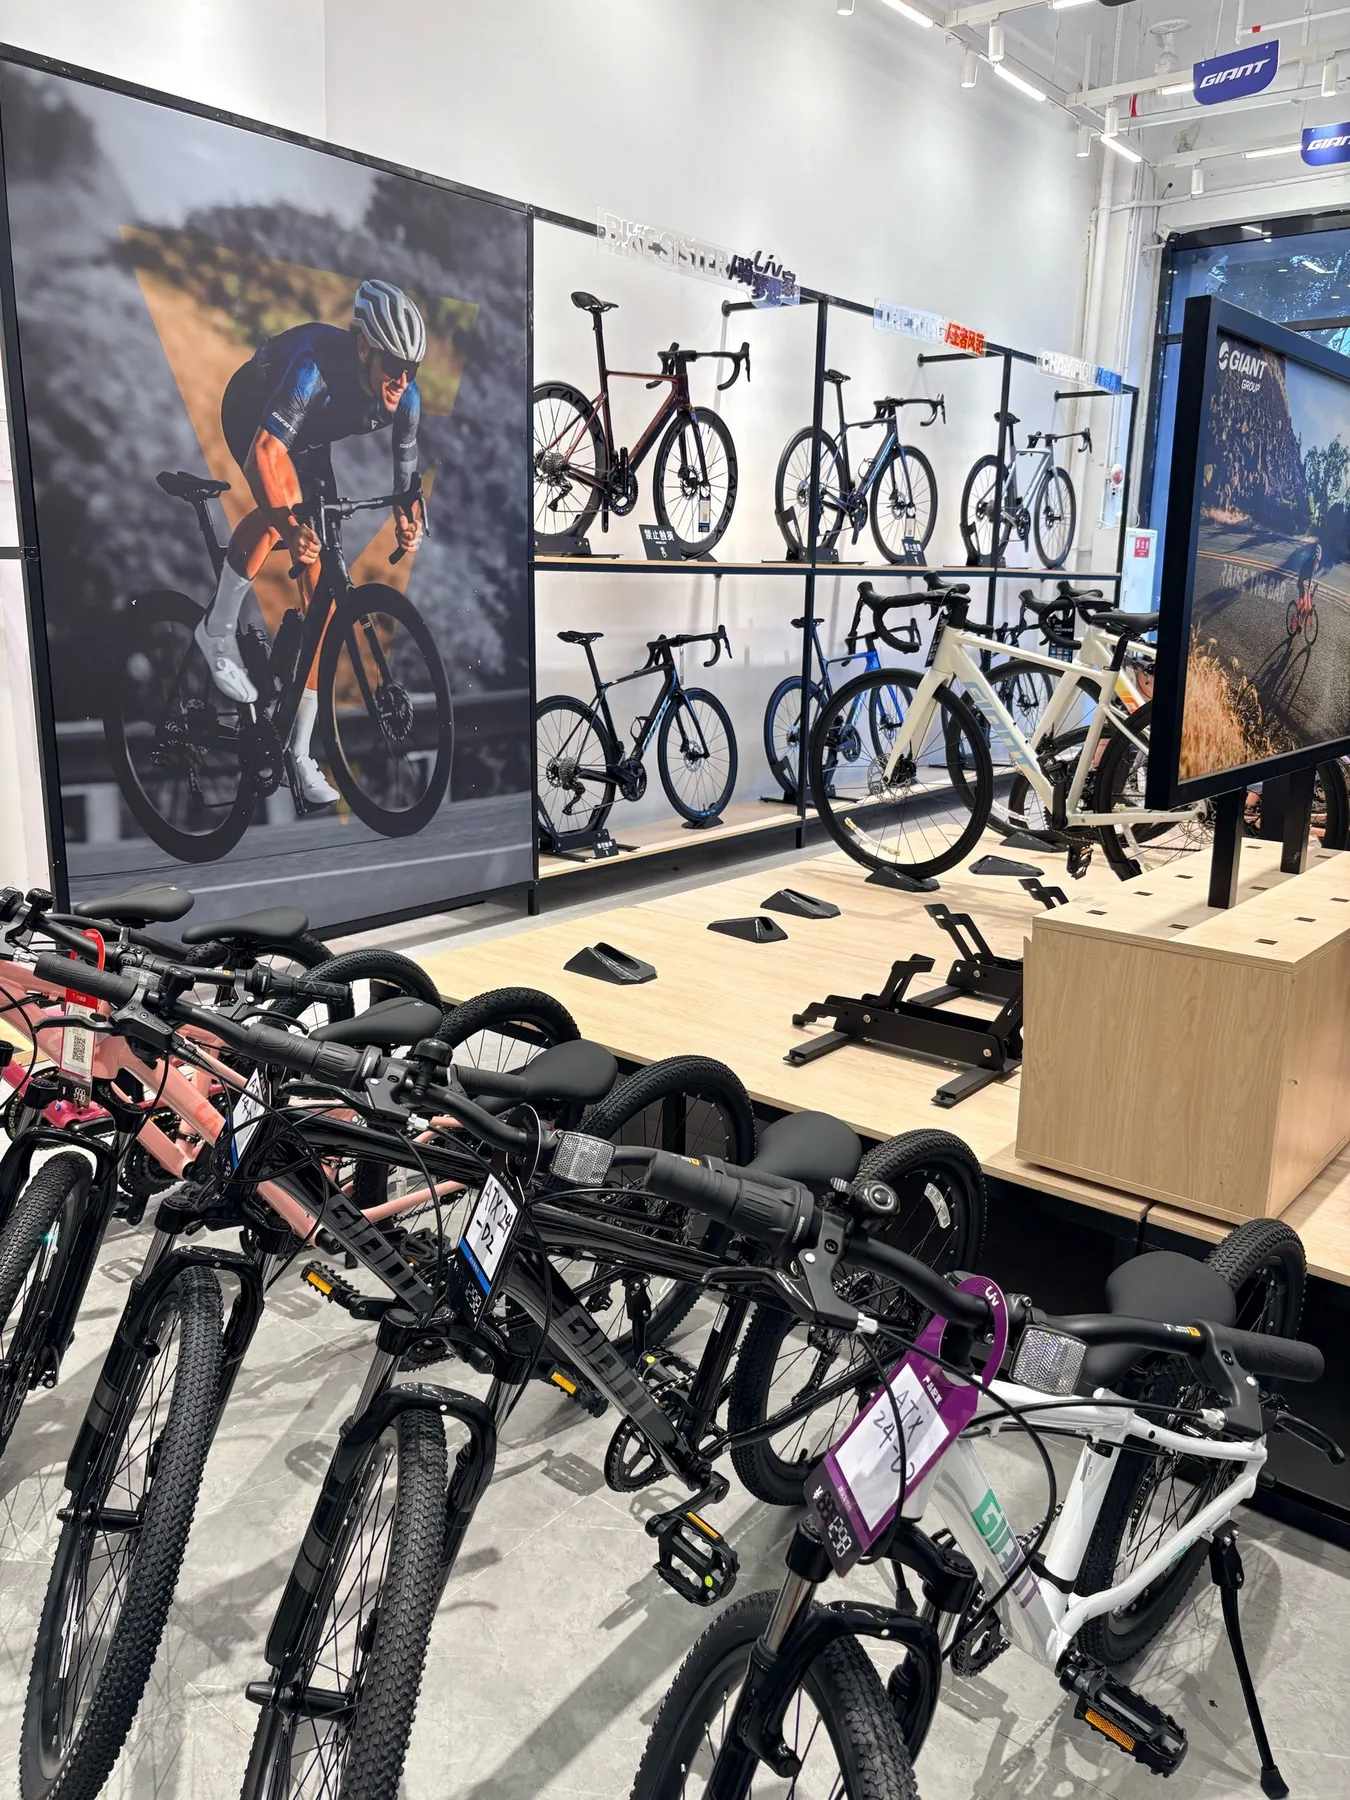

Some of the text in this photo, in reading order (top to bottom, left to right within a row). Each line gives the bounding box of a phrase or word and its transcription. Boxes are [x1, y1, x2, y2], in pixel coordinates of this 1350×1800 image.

[1200, 58, 1271, 89] GIANT
[660, 232, 730, 283] SISTER
[754, 250, 783, 277] Liv
[1229, 350, 1268, 379] GIANT
[1241, 379, 1261, 393] GROUP
[272, 411, 297, 435] GIANT
[1219, 563, 1287, 603] RAISE THE BAR
[480, 1181, 503, 1221] ATX
[498, 1205, 513, 1238] 24
[323, 1193, 434, 1300] GIANT
[985, 1285, 999, 1307] Liv
[552, 1304, 663, 1420] GIANT
[813, 1485, 824, 1499] ¥
